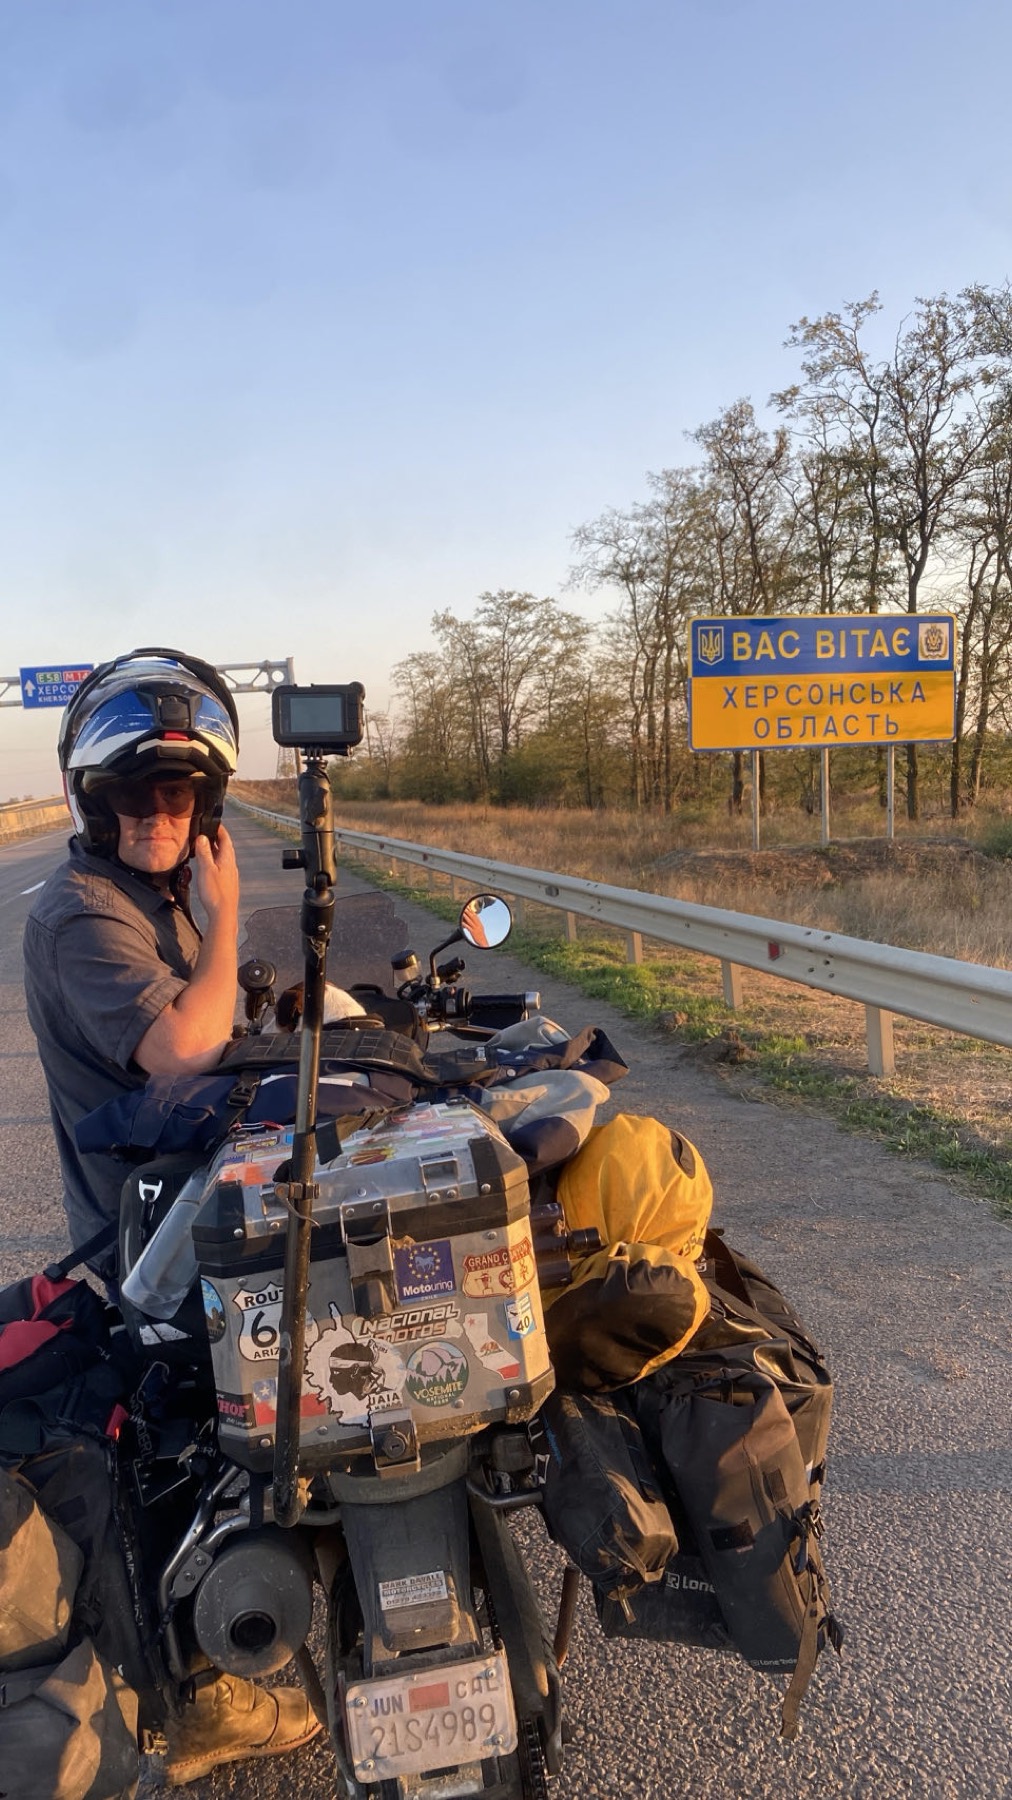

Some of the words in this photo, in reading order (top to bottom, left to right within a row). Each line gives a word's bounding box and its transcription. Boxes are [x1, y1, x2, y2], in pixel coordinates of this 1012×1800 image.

[732, 630, 801, 661] ВАС
[816, 627, 911, 659] ВІТАЄ
[722, 681, 926, 709] ХЕРСОНСЬКА
[754, 713, 899, 739] ОБЛАСТЬ
[468, 1253, 499, 1267] GRAND
[402, 1280, 453, 1297] Motouring
[516, 1315, 530, 1332] 40
[413, 1381, 464, 1400] YOSEMITE
[371, 1694, 403, 1718] JUN
[455, 1673, 500, 1699] CAL
[371, 1703, 496, 1760] 21S4989
